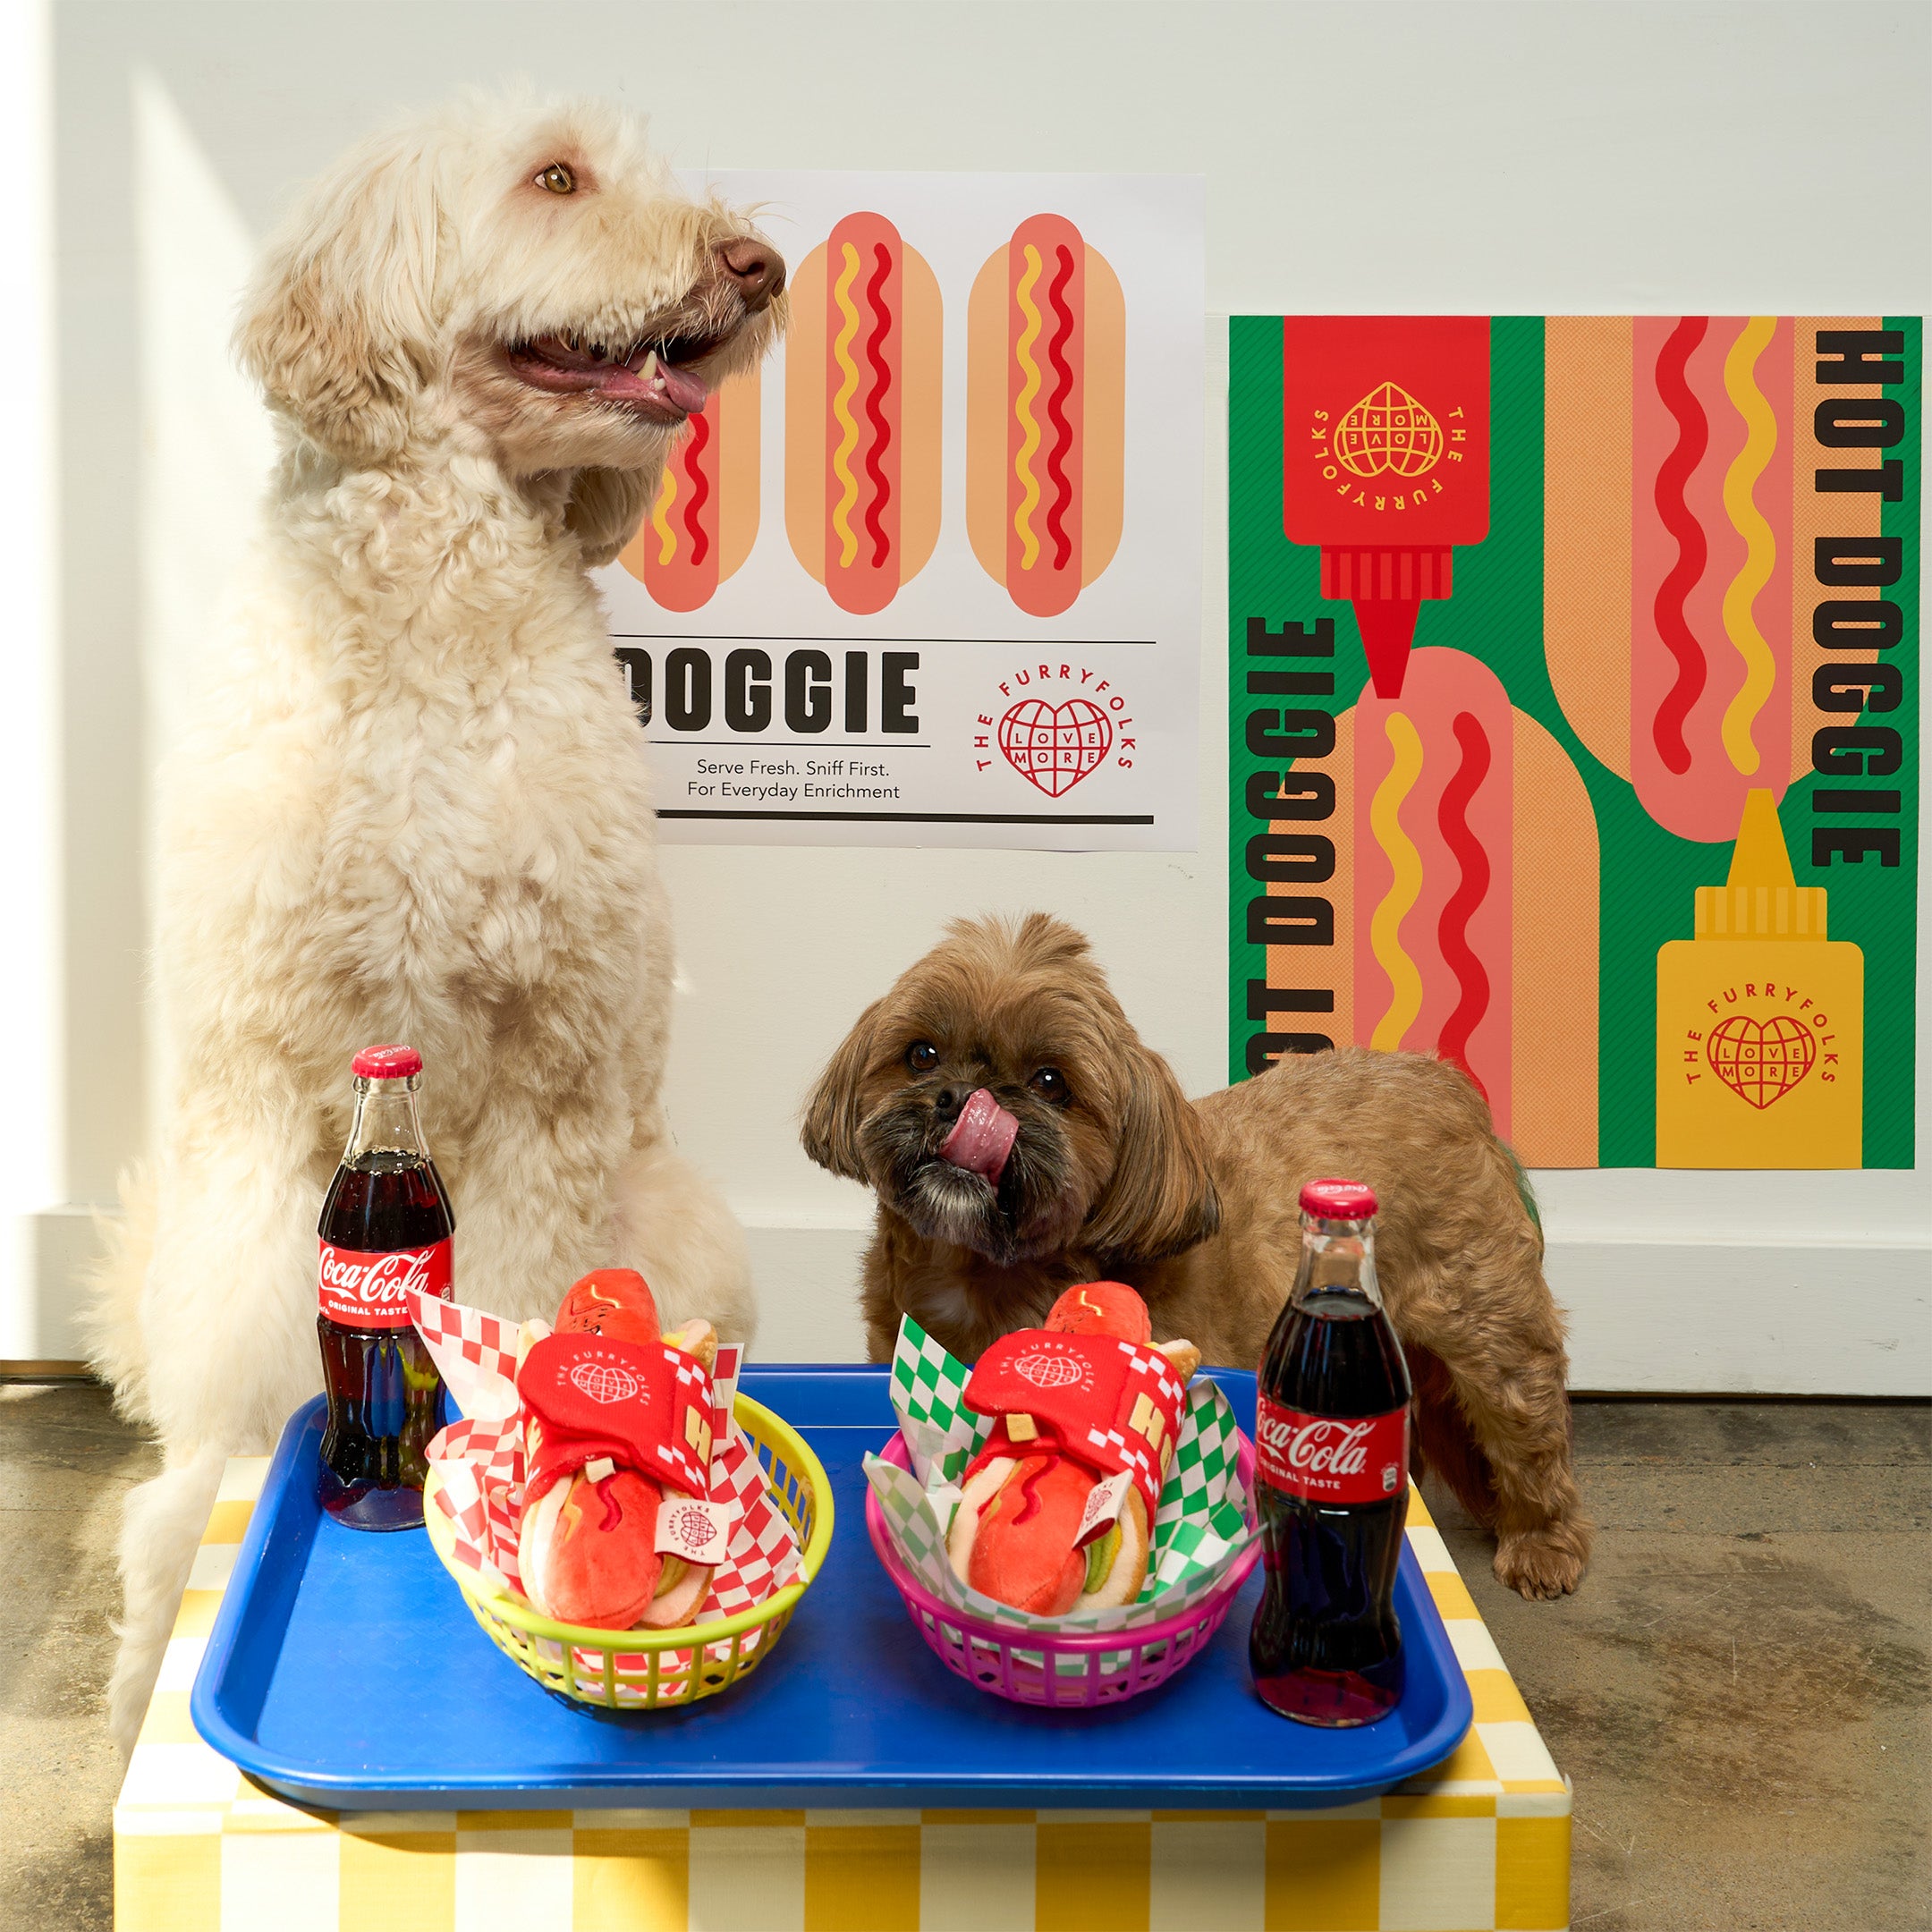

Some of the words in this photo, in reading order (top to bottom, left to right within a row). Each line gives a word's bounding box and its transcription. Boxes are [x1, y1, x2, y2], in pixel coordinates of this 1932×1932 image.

[1351, 415, 1428, 426] MORE
[1814, 330, 1905, 502] HOT
[1350, 433, 1426, 445] LOVE
[1448, 407, 1466, 462] THE
[1311, 410, 1443, 511] FURRYFOLKS
[1811, 537, 1903, 867] DOGGIE
[974, 715, 993, 772] THE
[999, 665, 1136, 768] FURRYFOLKS
[1016, 733, 1095, 743] LOVE
[1015, 752, 1094, 763] MORE
[697, 759, 744, 775] Serve
[750, 760, 801, 775] Fresh.
[806, 760, 843, 775] Sniff
[849, 761, 890, 776] First.
[1246, 617, 1335, 945] DOGGIE
[688, 782, 716, 796] For
[722, 782, 798, 801] Everyday
[804, 783, 900, 799] Enrichment
[1684, 1030, 1702, 1084] THE
[1707, 983, 1838, 1082] FURRYFOLKS
[1724, 1048, 1800, 1058] LOVE
[1723, 1066, 1800, 1077] MORE
[320, 1247, 436, 1302] Coca-Cola
[328, 1300, 371, 1316] ORIGINAL
[374, 1306, 408, 1316] TASTE
[1303, 1476, 1341, 1489] TASTE
